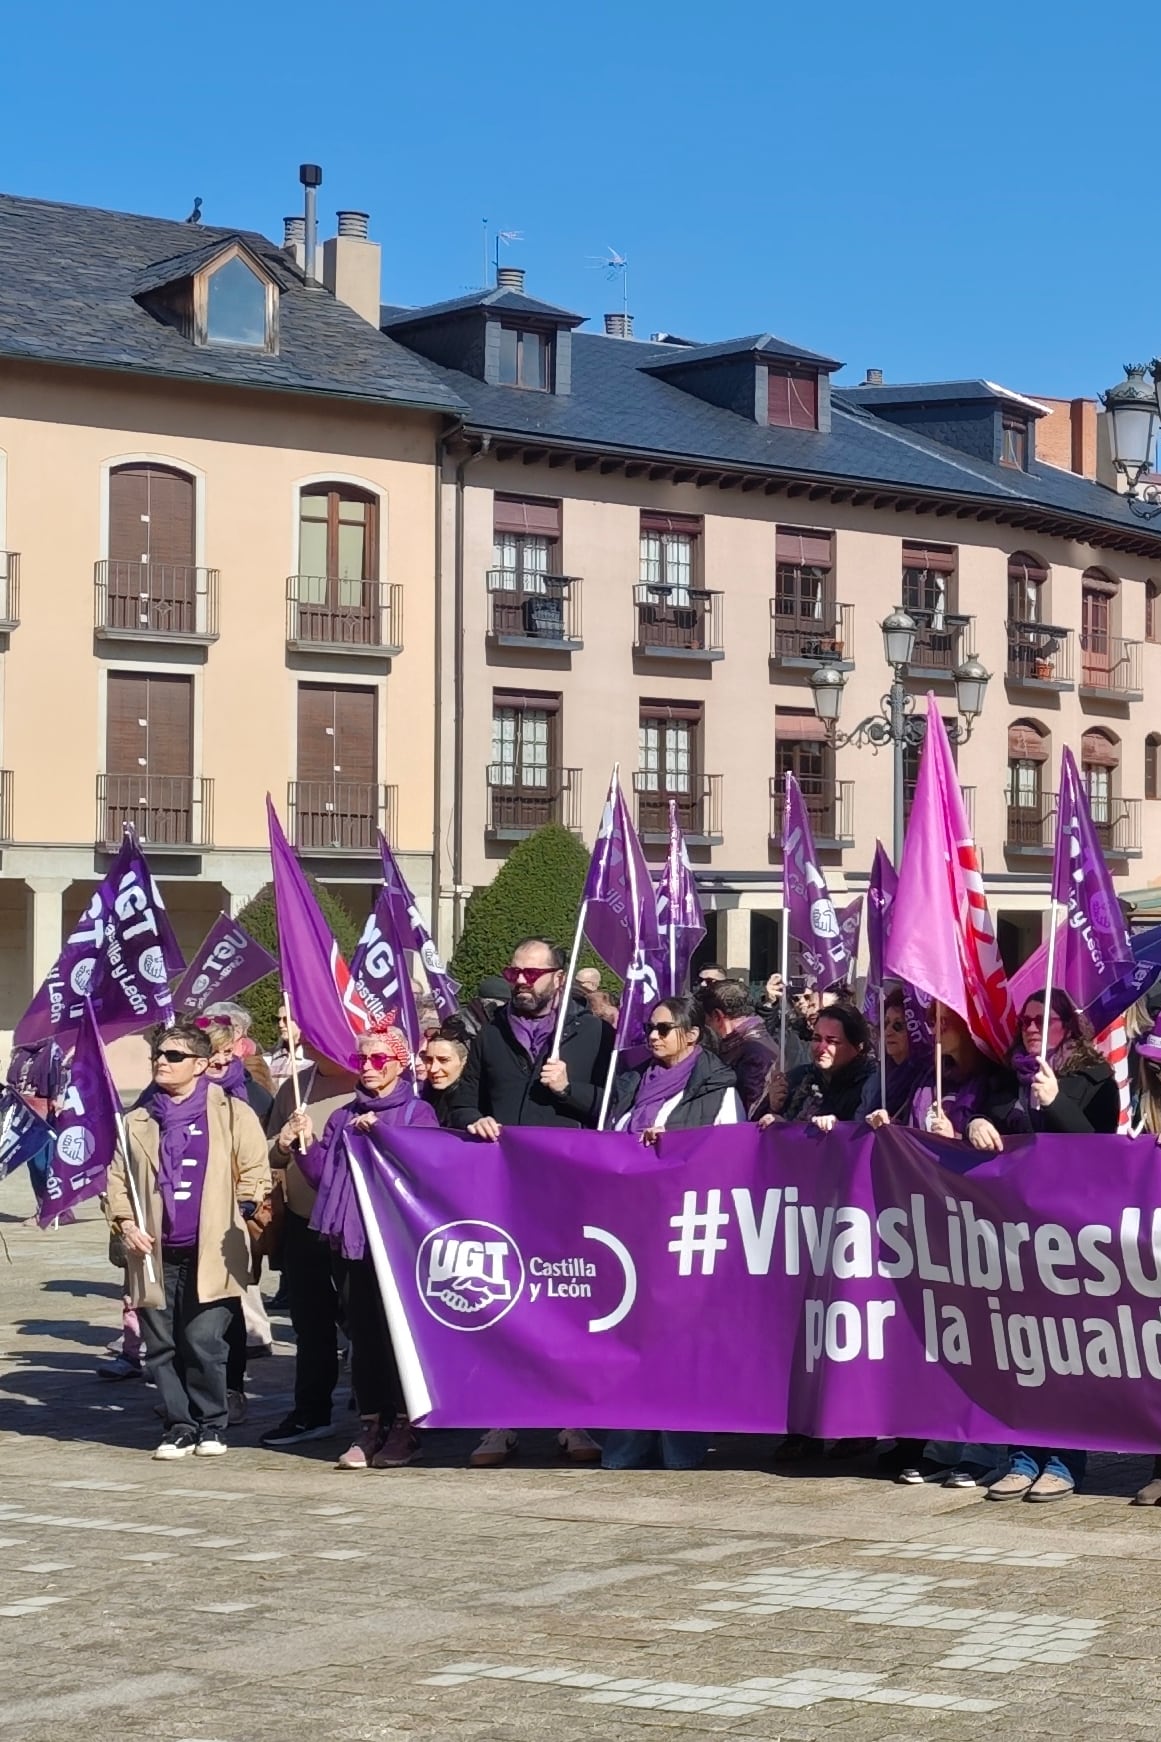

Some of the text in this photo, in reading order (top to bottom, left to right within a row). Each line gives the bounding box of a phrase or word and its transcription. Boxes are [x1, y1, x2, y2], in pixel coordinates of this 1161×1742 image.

[119, 972, 148, 1015] León
[429, 1239, 509, 1285] UGT
[529, 1257, 597, 1278] Castilla
[529, 1277, 592, 1303] y León
[804, 1298, 896, 1373] por
[924, 1288, 972, 1366] la
